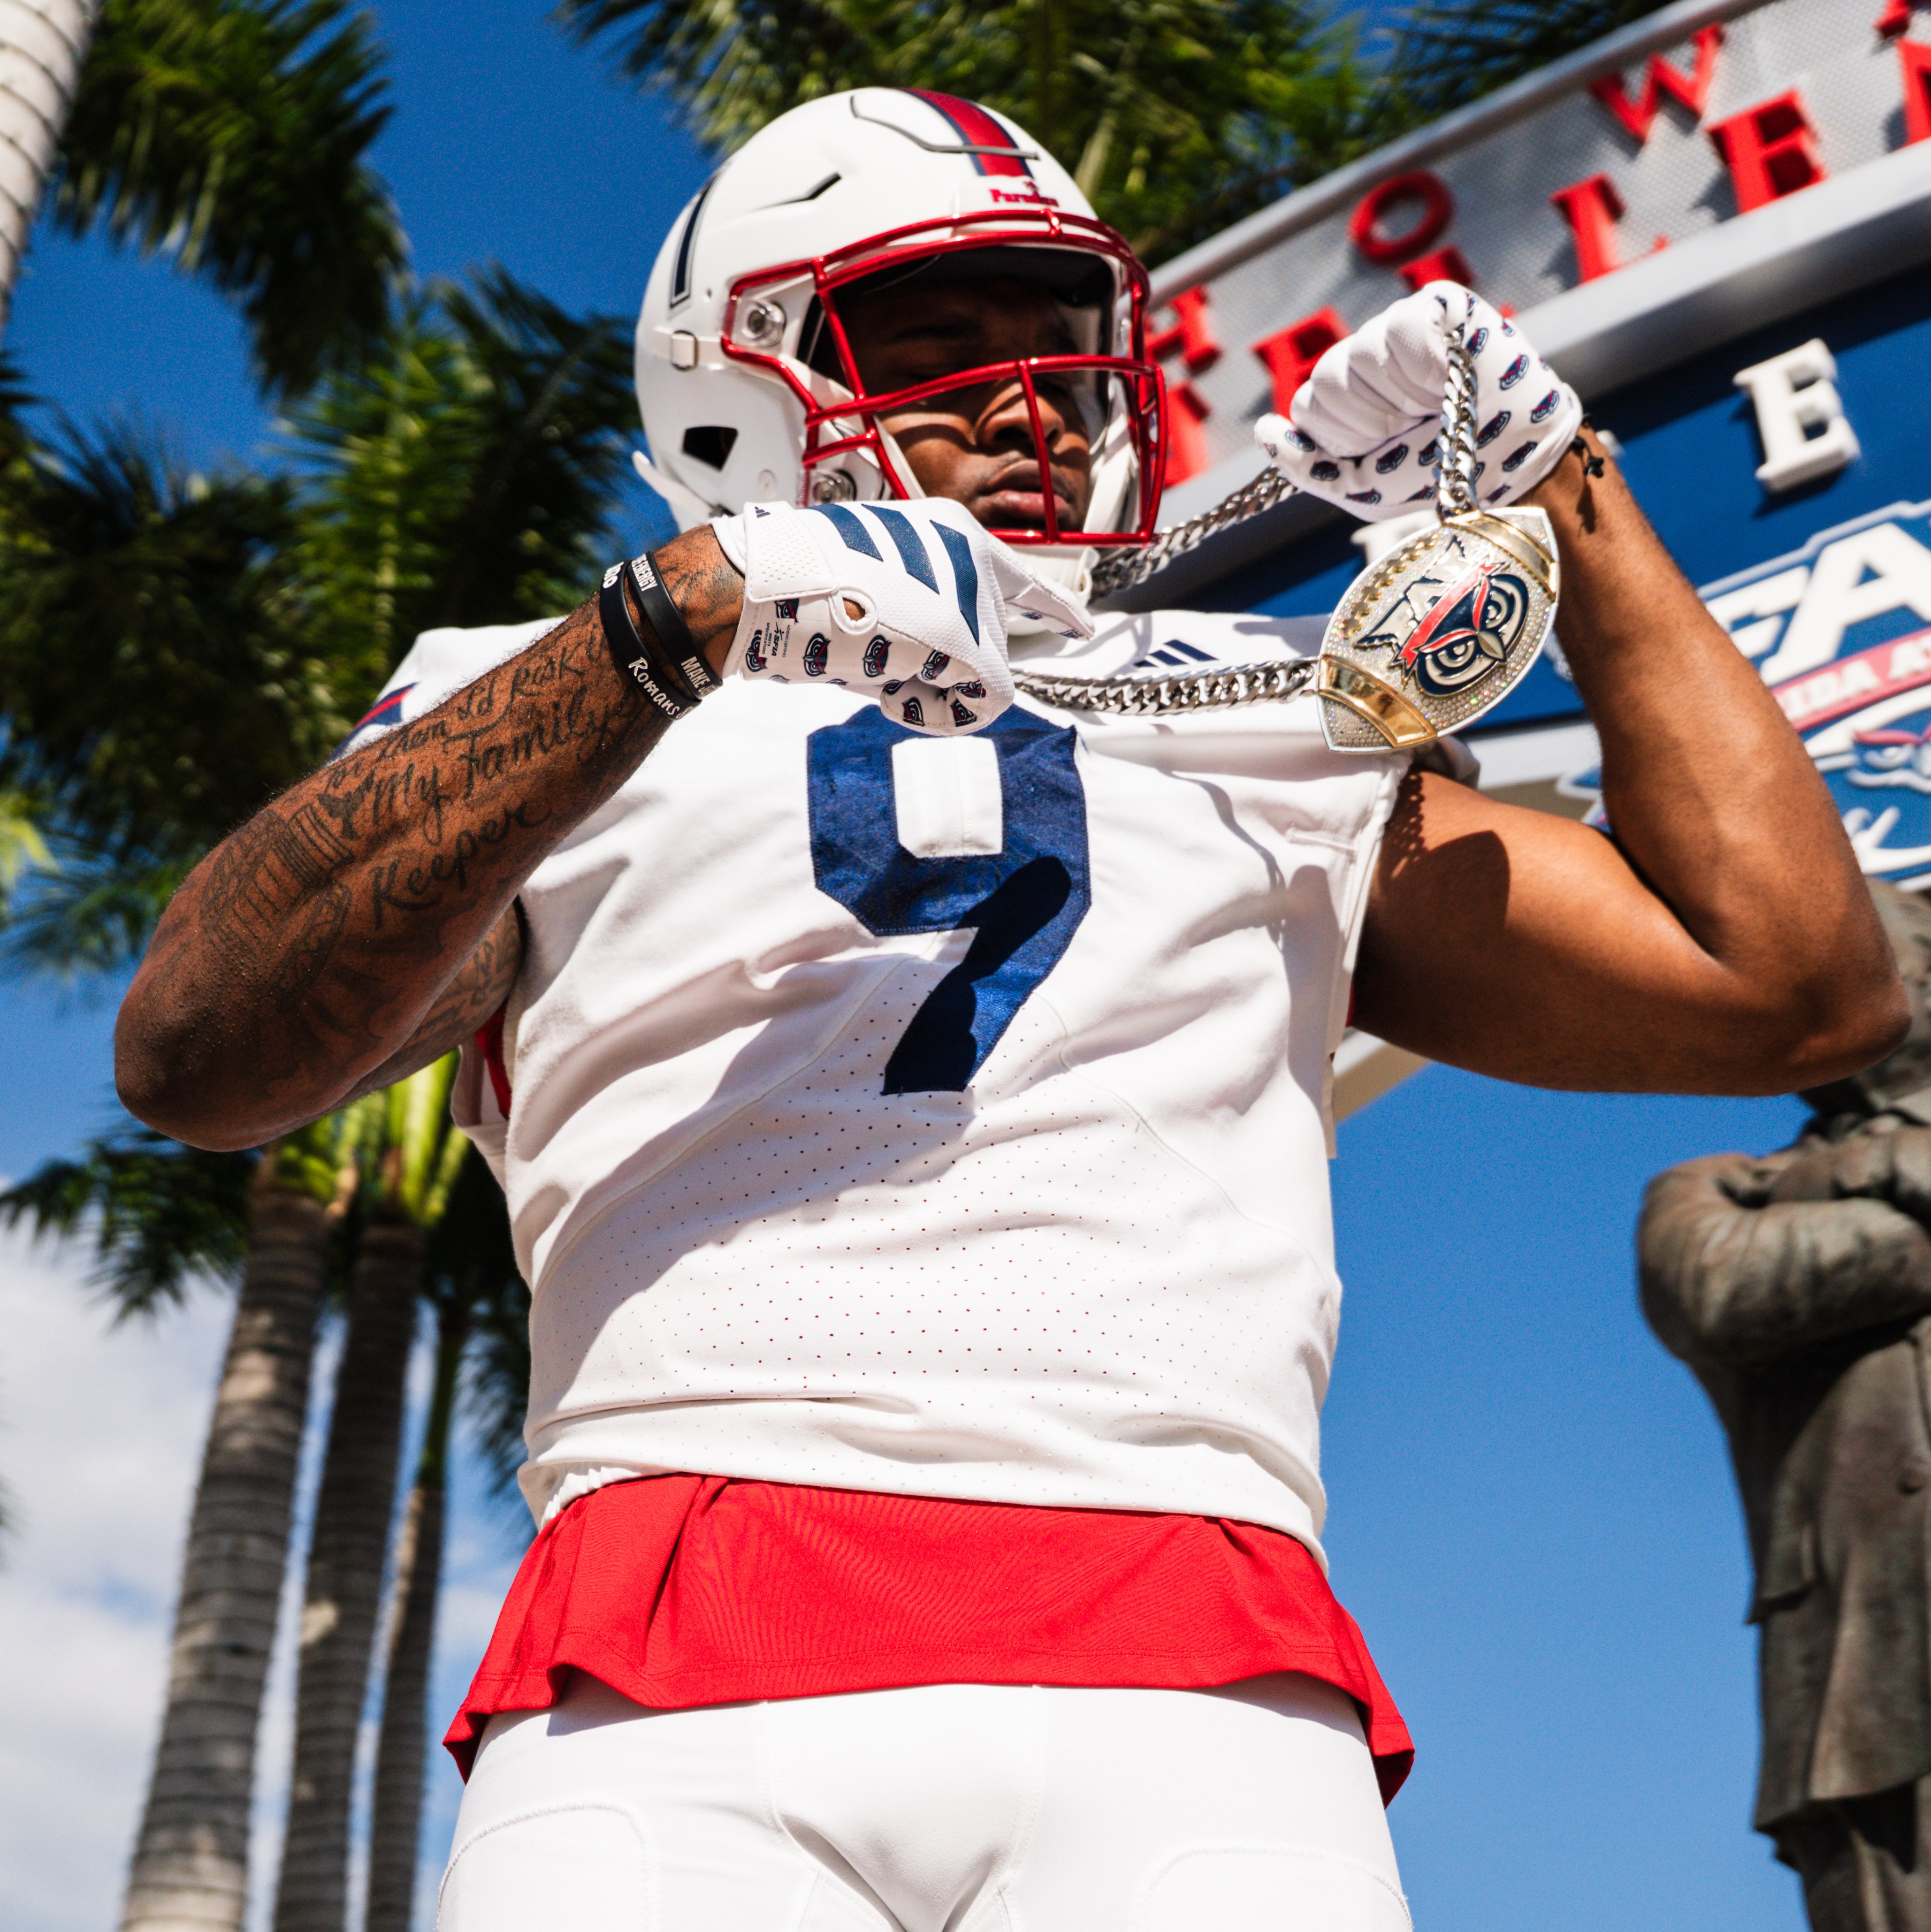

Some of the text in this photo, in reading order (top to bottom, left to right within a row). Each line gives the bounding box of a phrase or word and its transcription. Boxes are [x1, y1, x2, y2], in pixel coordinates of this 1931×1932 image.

[772, 634, 780, 656] SFIA
[628, 657, 680, 716] Romans
[681, 656, 711, 689] MAKE
[806, 703, 1092, 1097] 9
